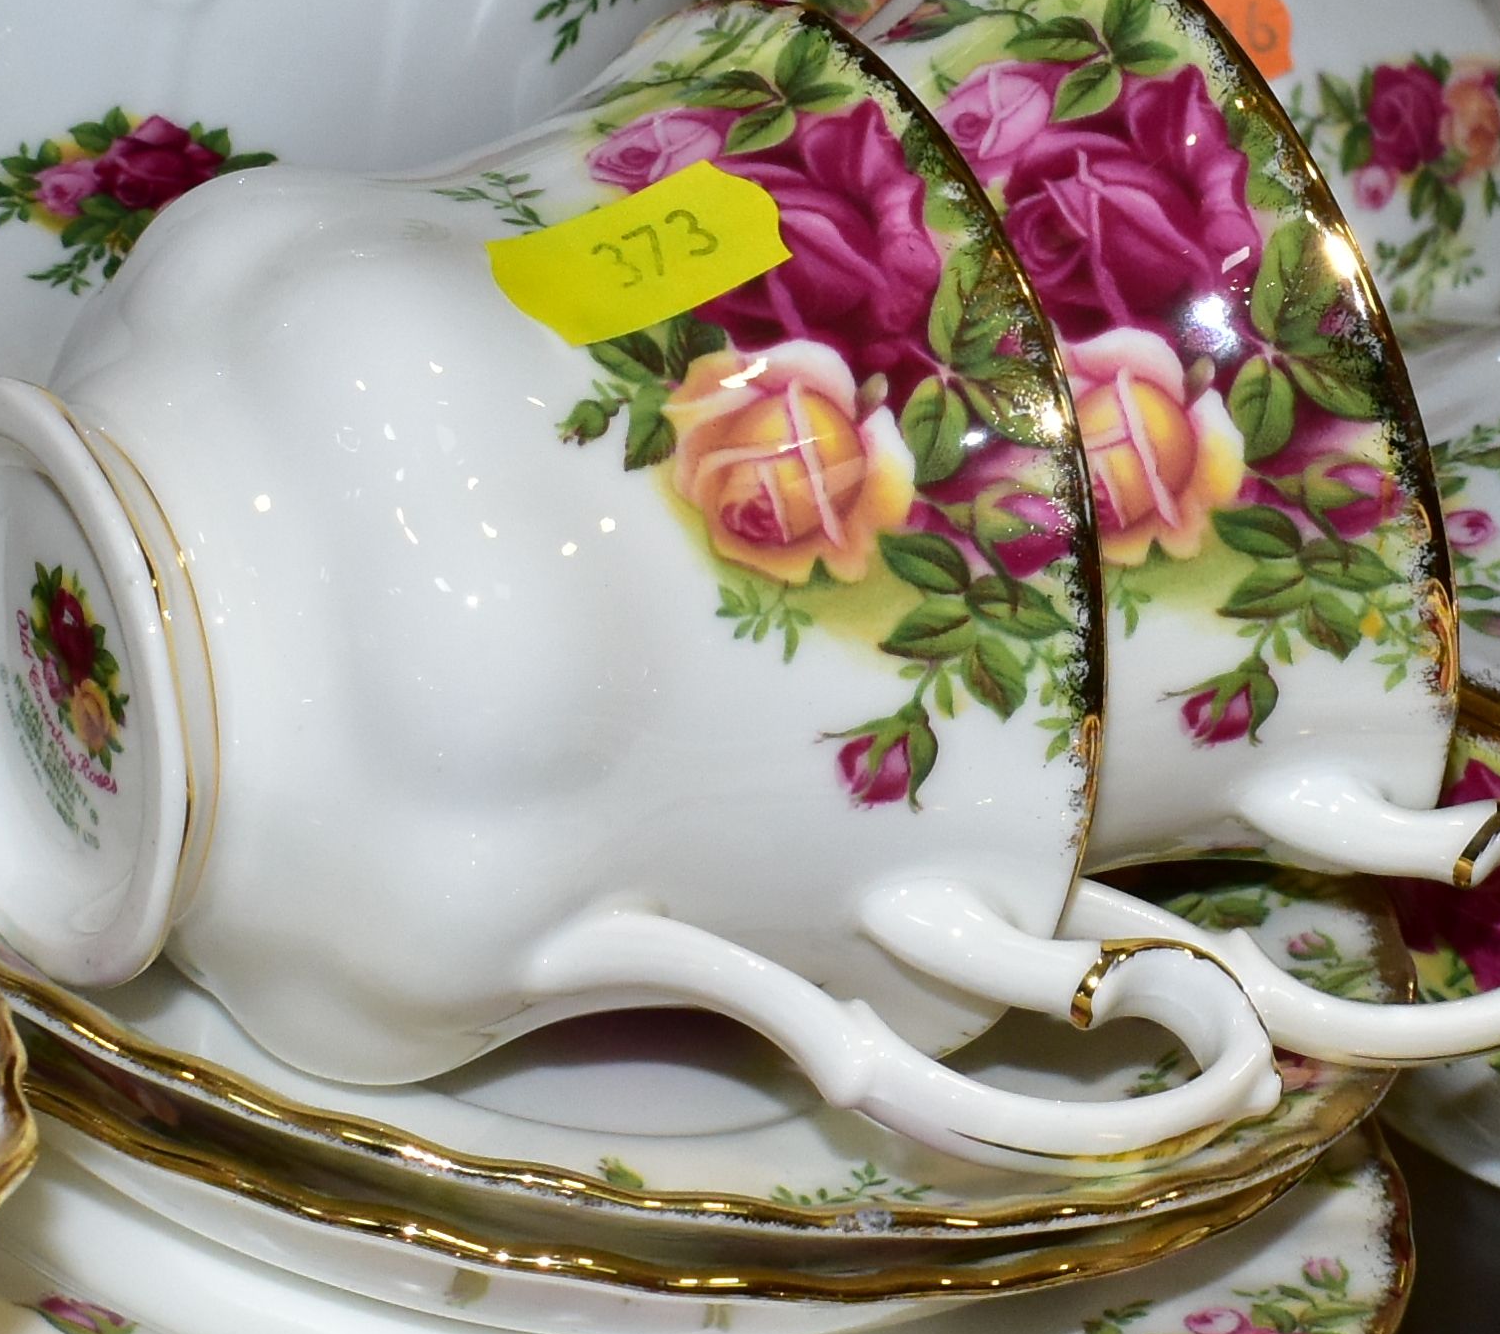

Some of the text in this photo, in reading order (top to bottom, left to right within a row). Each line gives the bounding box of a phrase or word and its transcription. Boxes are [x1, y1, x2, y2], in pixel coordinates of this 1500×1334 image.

[591, 208, 719, 288] 373
[17, 610, 34, 658] Old
[29, 663, 77, 771] Country
[75, 753, 118, 794] Roses
